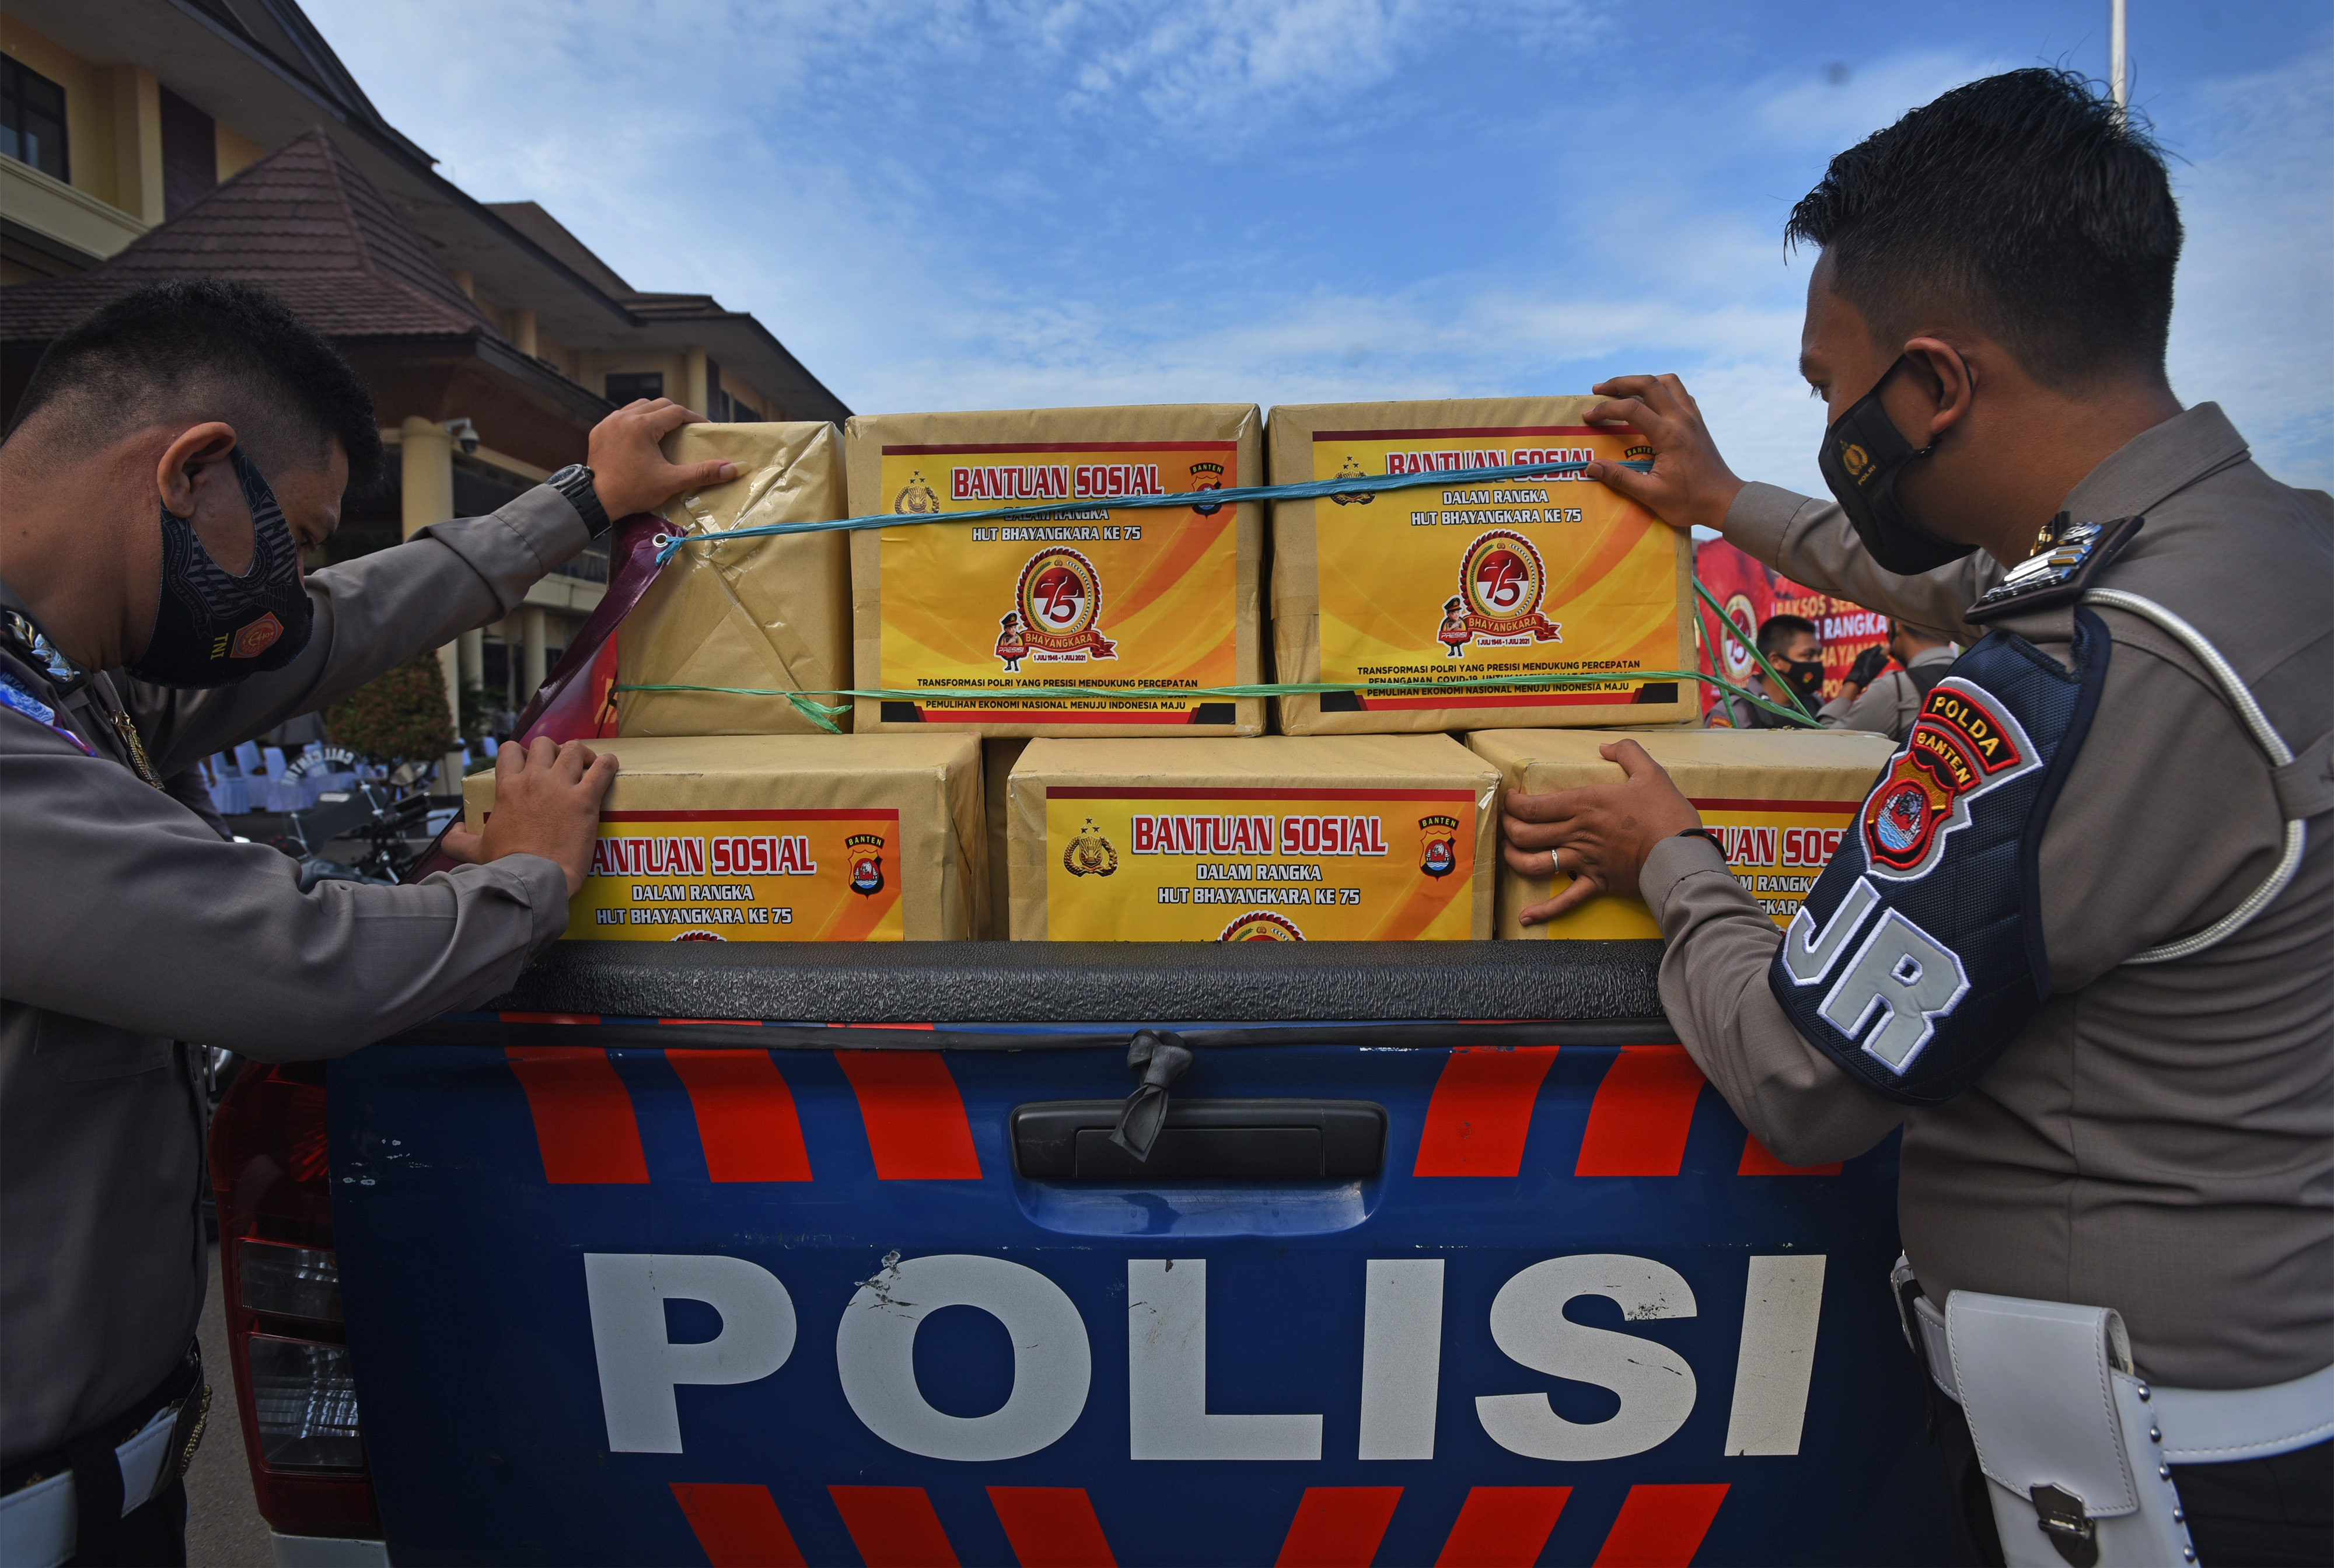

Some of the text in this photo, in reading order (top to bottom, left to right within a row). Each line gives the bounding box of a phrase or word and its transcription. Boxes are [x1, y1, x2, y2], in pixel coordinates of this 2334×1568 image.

[1193, 464, 1221, 473] BANTEN
[1858, 465, 1876, 486] POLRI
[952, 464, 1165, 500] BANTUAN SOSIAL
[1442, 489, 1549, 505] DALAM RANGKA
[1054, 508, 1109, 521] RANGKA
[1411, 509, 1582, 526] HUT BHAYANGKARA KE 75
[972, 526, 1142, 542] HUT BHAYANGKARA KE 75
[1482, 558, 1523, 607] 75
[1039, 575, 1079, 623] 75
[1469, 616, 1537, 632] BHAYANGKARA
[1824, 613, 1888, 640] RANGKA
[210, 632, 229, 661] TNI
[1025, 633, 1093, 648] BHAYANGKARA
[1357, 660, 1640, 675] TRANSFORMASI POLRI YANG PRESISI MENDUKUNG PERCEPATAN
[917, 679, 985, 687] TRANSFORMASI
[987, 679, 1013, 687] POLRI
[1079, 679, 1135, 687] MENDUKUNG
[1138, 679, 1198, 687] PERCEPATAN
[1437, 675, 1478, 683] COVID-19
[1367, 682, 1629, 697] PEMULIHAN EKONOMI NASIONAL MENUJU INDONESIA MAJU
[925, 700, 976, 708] PEMULIHAN
[979, 700, 1020, 708] EKONOMI
[1022, 701, 1068, 709] NASIONAL
[1109, 701, 1158, 710] INDONESIA
[1161, 701, 1186, 710] MAJU
[1931, 696, 2000, 757] POLDA
[1916, 731, 1970, 784] BANTEN
[1421, 815, 1457, 827] BANTEN
[847, 834, 883, 848] BANTEN
[1131, 814, 1389, 856] BANTUAN SOSIAL
[588, 835, 817, 876] ANTUAN SOSIAL
[1783, 827, 1848, 867] SOS
[1196, 864, 1322, 882] DALAM RANGKA
[631, 884, 754, 901] DALAM RANGKA
[1158, 887, 1361, 905] HUT BHAYANGKARA KE 75
[596, 906, 793, 925] HUT BHAYANGKARA KE 75
[1783, 876, 1972, 1077] JR
[584, 1252, 1828, 1461] POLISI
